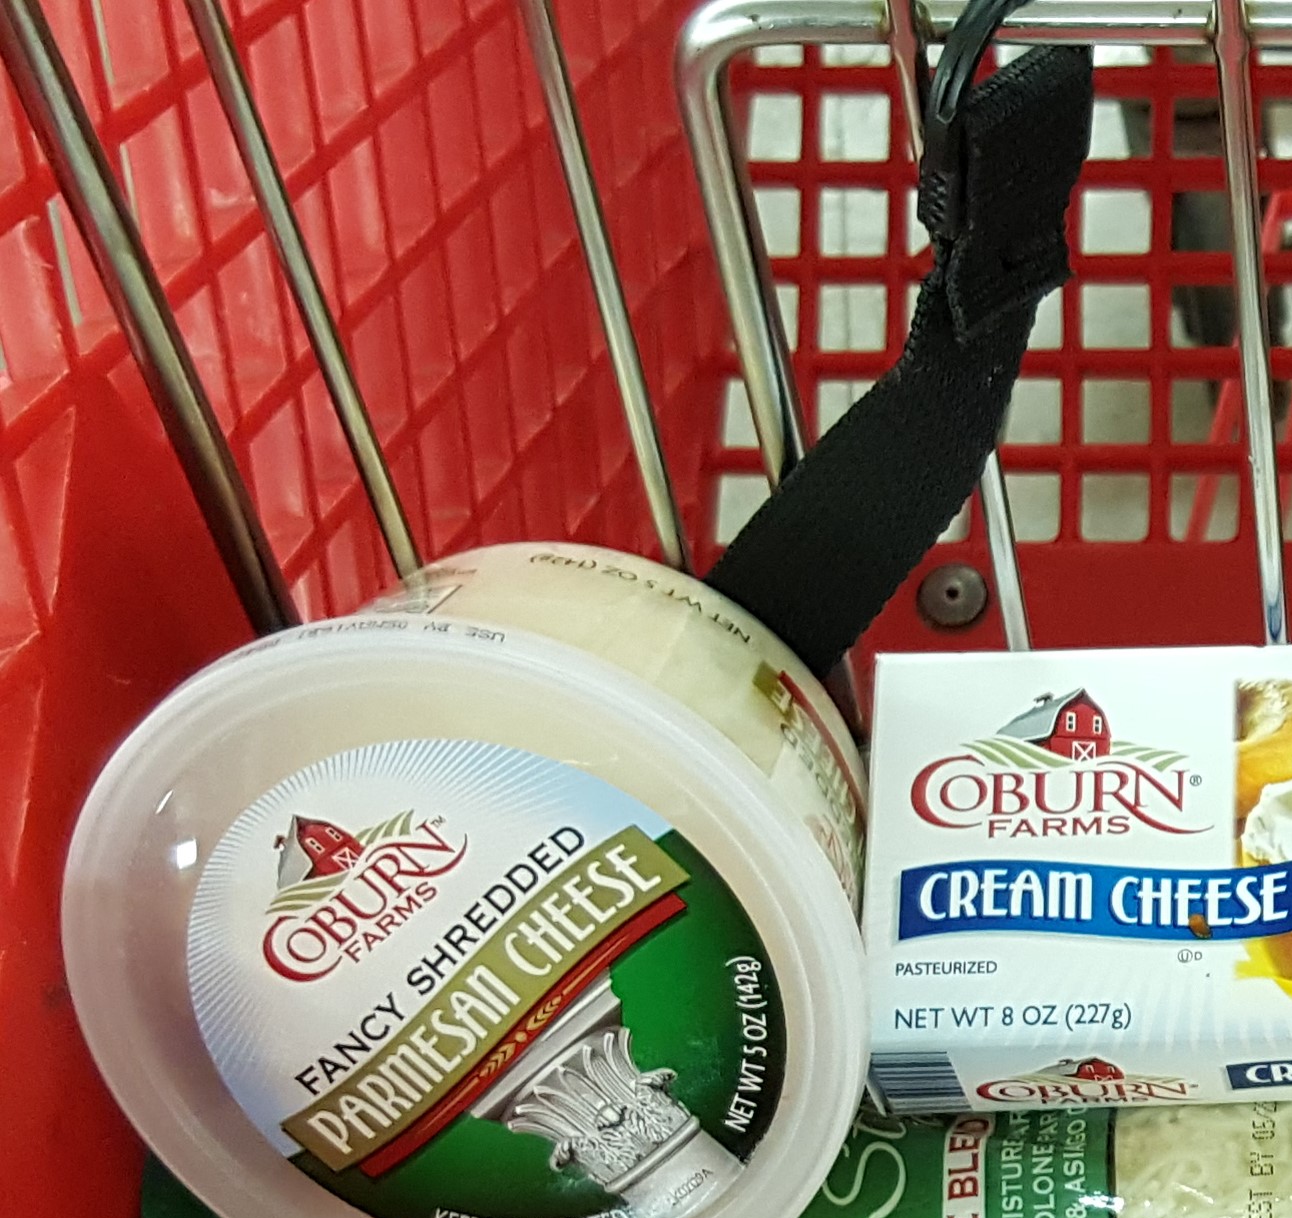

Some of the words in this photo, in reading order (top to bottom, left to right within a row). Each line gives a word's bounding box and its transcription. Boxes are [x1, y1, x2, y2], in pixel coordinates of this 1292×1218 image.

[601, 564, 638, 581] OZ
[663, 588, 702, 612] WT
[708, 613, 751, 643] NET
[910, 755, 1215, 835] COBURN
[987, 815, 1132, 840] FARMS
[262, 819, 468, 983] COBURN
[918, 868, 1094, 921] CREAM
[1109, 871, 1290, 927] CHEESE
[343, 882, 439, 964] FARMS
[295, 993, 407, 1096] FANCY
[407, 826, 586, 996] SHREDDED
[895, 960, 998, 977] PASTEURIZED
[725, 954, 768, 1011] (142g)
[308, 964, 522, 1155] PARMESAN
[504, 843, 663, 977] CHEESE
[743, 1012, 768, 1041] OZ
[894, 1008, 945, 1030] NET
[951, 1007, 995, 1028] WT
[1001, 1006, 1015, 1027] 8
[1022, 1005, 1059, 1027] OZ
[1065, 1002, 1133, 1032] (227g)
[742, 1045, 768, 1058] 5
[734, 1061, 767, 1096] WT
[975, 1079, 1201, 1102] COBURN
[725, 1095, 755, 1134] NET
[1250, 1152, 1274, 1177] BY
